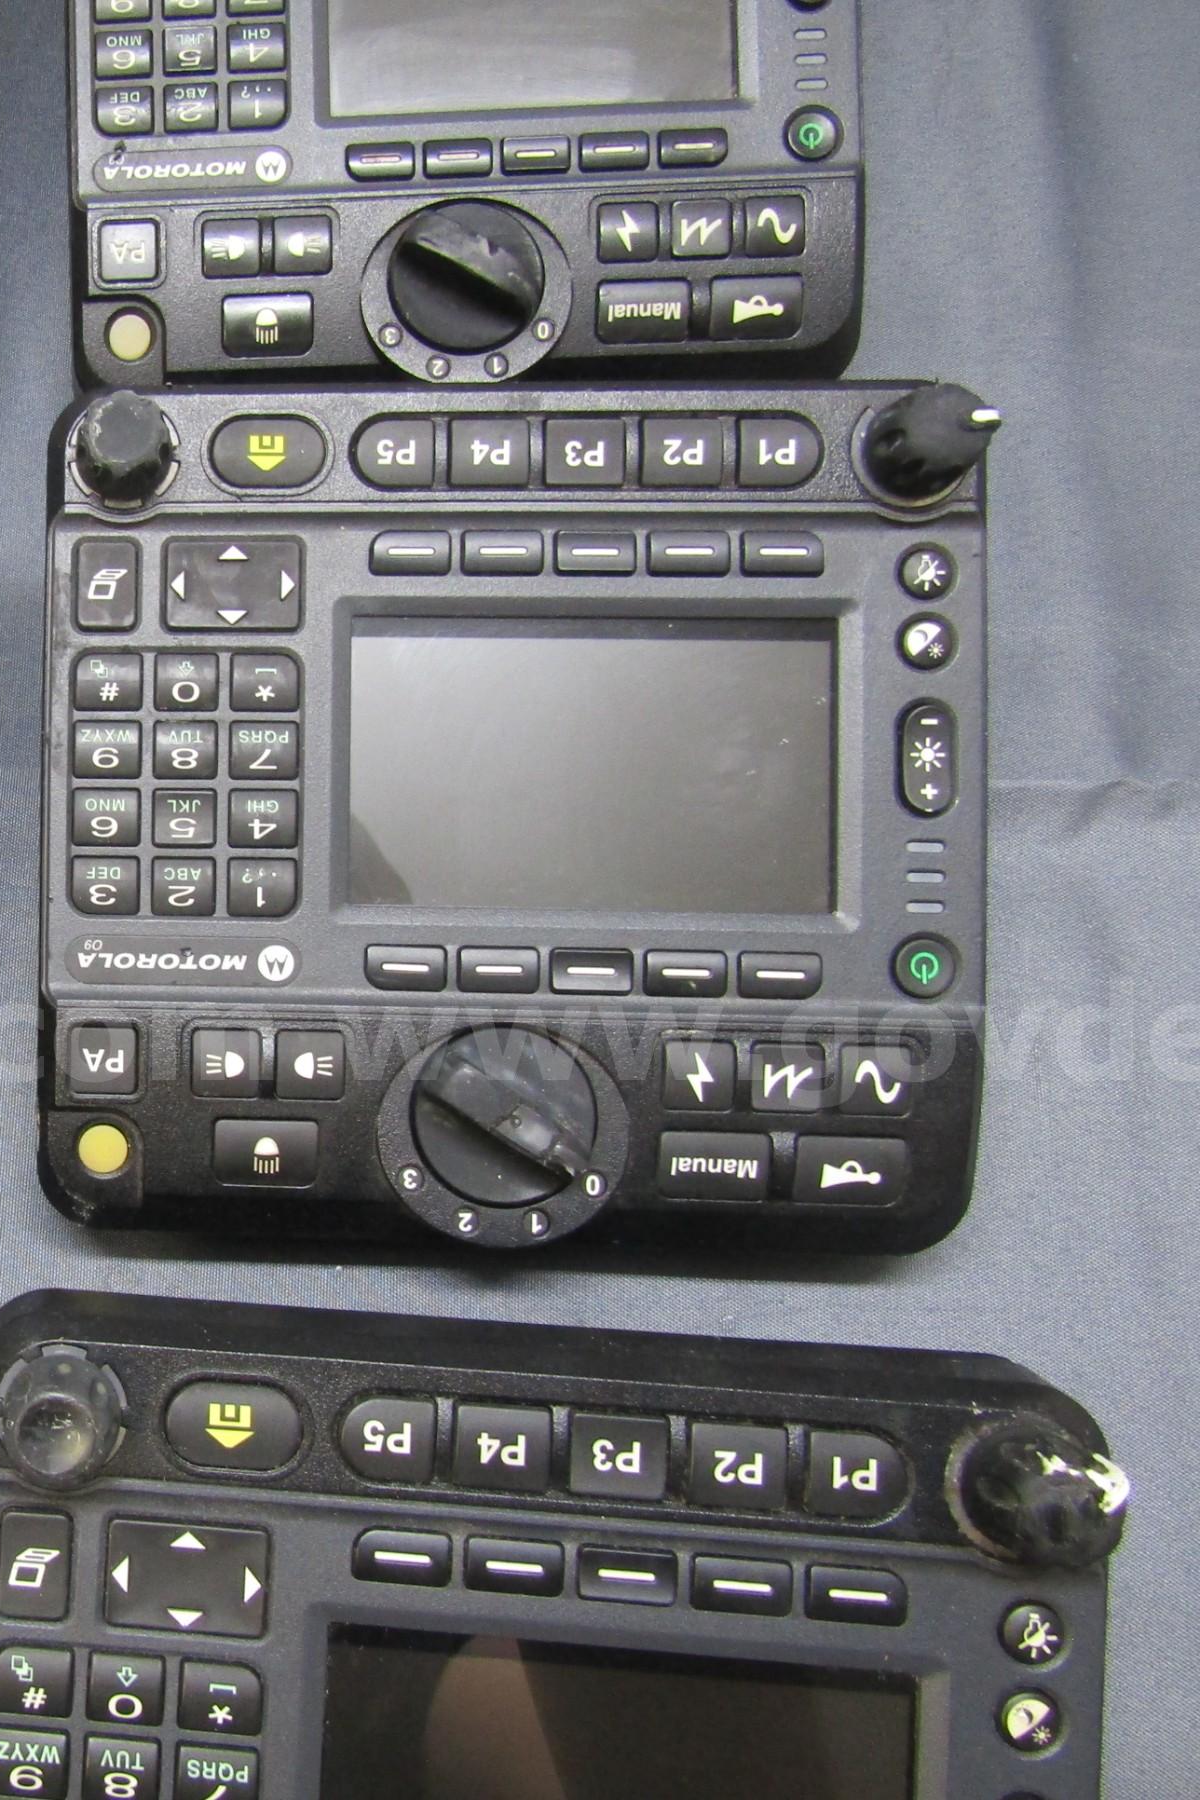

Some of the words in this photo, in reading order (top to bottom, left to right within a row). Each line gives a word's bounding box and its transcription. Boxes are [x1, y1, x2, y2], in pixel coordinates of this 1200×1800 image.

[106, 35, 142, 47] MNO
[242, 28, 271, 39] GHI
[112, 50, 136, 70] 6
[178, 49, 201, 67] 5
[249, 42, 269, 63] 4
[110, 91, 140, 103] DEF
[174, 87, 208, 99] ABC
[113, 105, 136, 125] 3
[179, 101, 202, 122] 2
[253, 99, 262, 119] 1
[103, 161, 246, 180] MOTOROLA
[110, 240, 145, 264] PA
[608, 300, 681, 322] Manual
[384, 328, 397, 345] 3
[537, 322, 549, 340] 0
[432, 360, 444, 376] 2
[492, 357, 502, 376] 1
[377, 440, 416, 465] P5
[471, 440, 511, 466] P4
[565, 441, 605, 467] P3
[663, 440, 704, 466] P2
[759, 440, 796, 465] P1
[81, 730, 134, 743] WXYZ
[168, 730, 203, 743] TUV
[238, 730, 290, 744] PQRS
[92, 748, 119, 769] 9
[170, 748, 198, 769] 8
[249, 749, 278, 769] 7
[85, 798, 125, 811] MNO
[167, 799, 201, 811] JKL
[247, 800, 279, 813] GHI
[91, 817, 118, 838] 6
[169, 818, 197, 838] 5
[248, 819, 277, 839] 4
[86, 867, 121, 880] DEF
[163, 867, 201, 880] ABC
[89, 884, 118, 906] 3
[167, 885, 196, 906] 2
[256, 887, 266, 907] 1
[77, 952, 247, 970] MOTOROLA
[82, 1047, 125, 1073] PA
[670, 1156, 758, 1178] Manual
[402, 1170, 418, 1190] 3
[585, 1174, 601, 1195] 0
[458, 1213, 473, 1232] 2
[531, 1214, 543, 1233] 1
[362, 1420, 412, 1455] P5
[477, 1432, 526, 1467] P4
[592, 1438, 642, 1473] P3
[714, 1450, 764, 1485] P2
[832, 1456, 879, 1491] P1
[101, 1750, 144, 1771] TUV
[9, 1766, 44, 1791] 9
[187, 1759, 249, 1783] PQRS
[103, 1773, 138, 1799] 8
